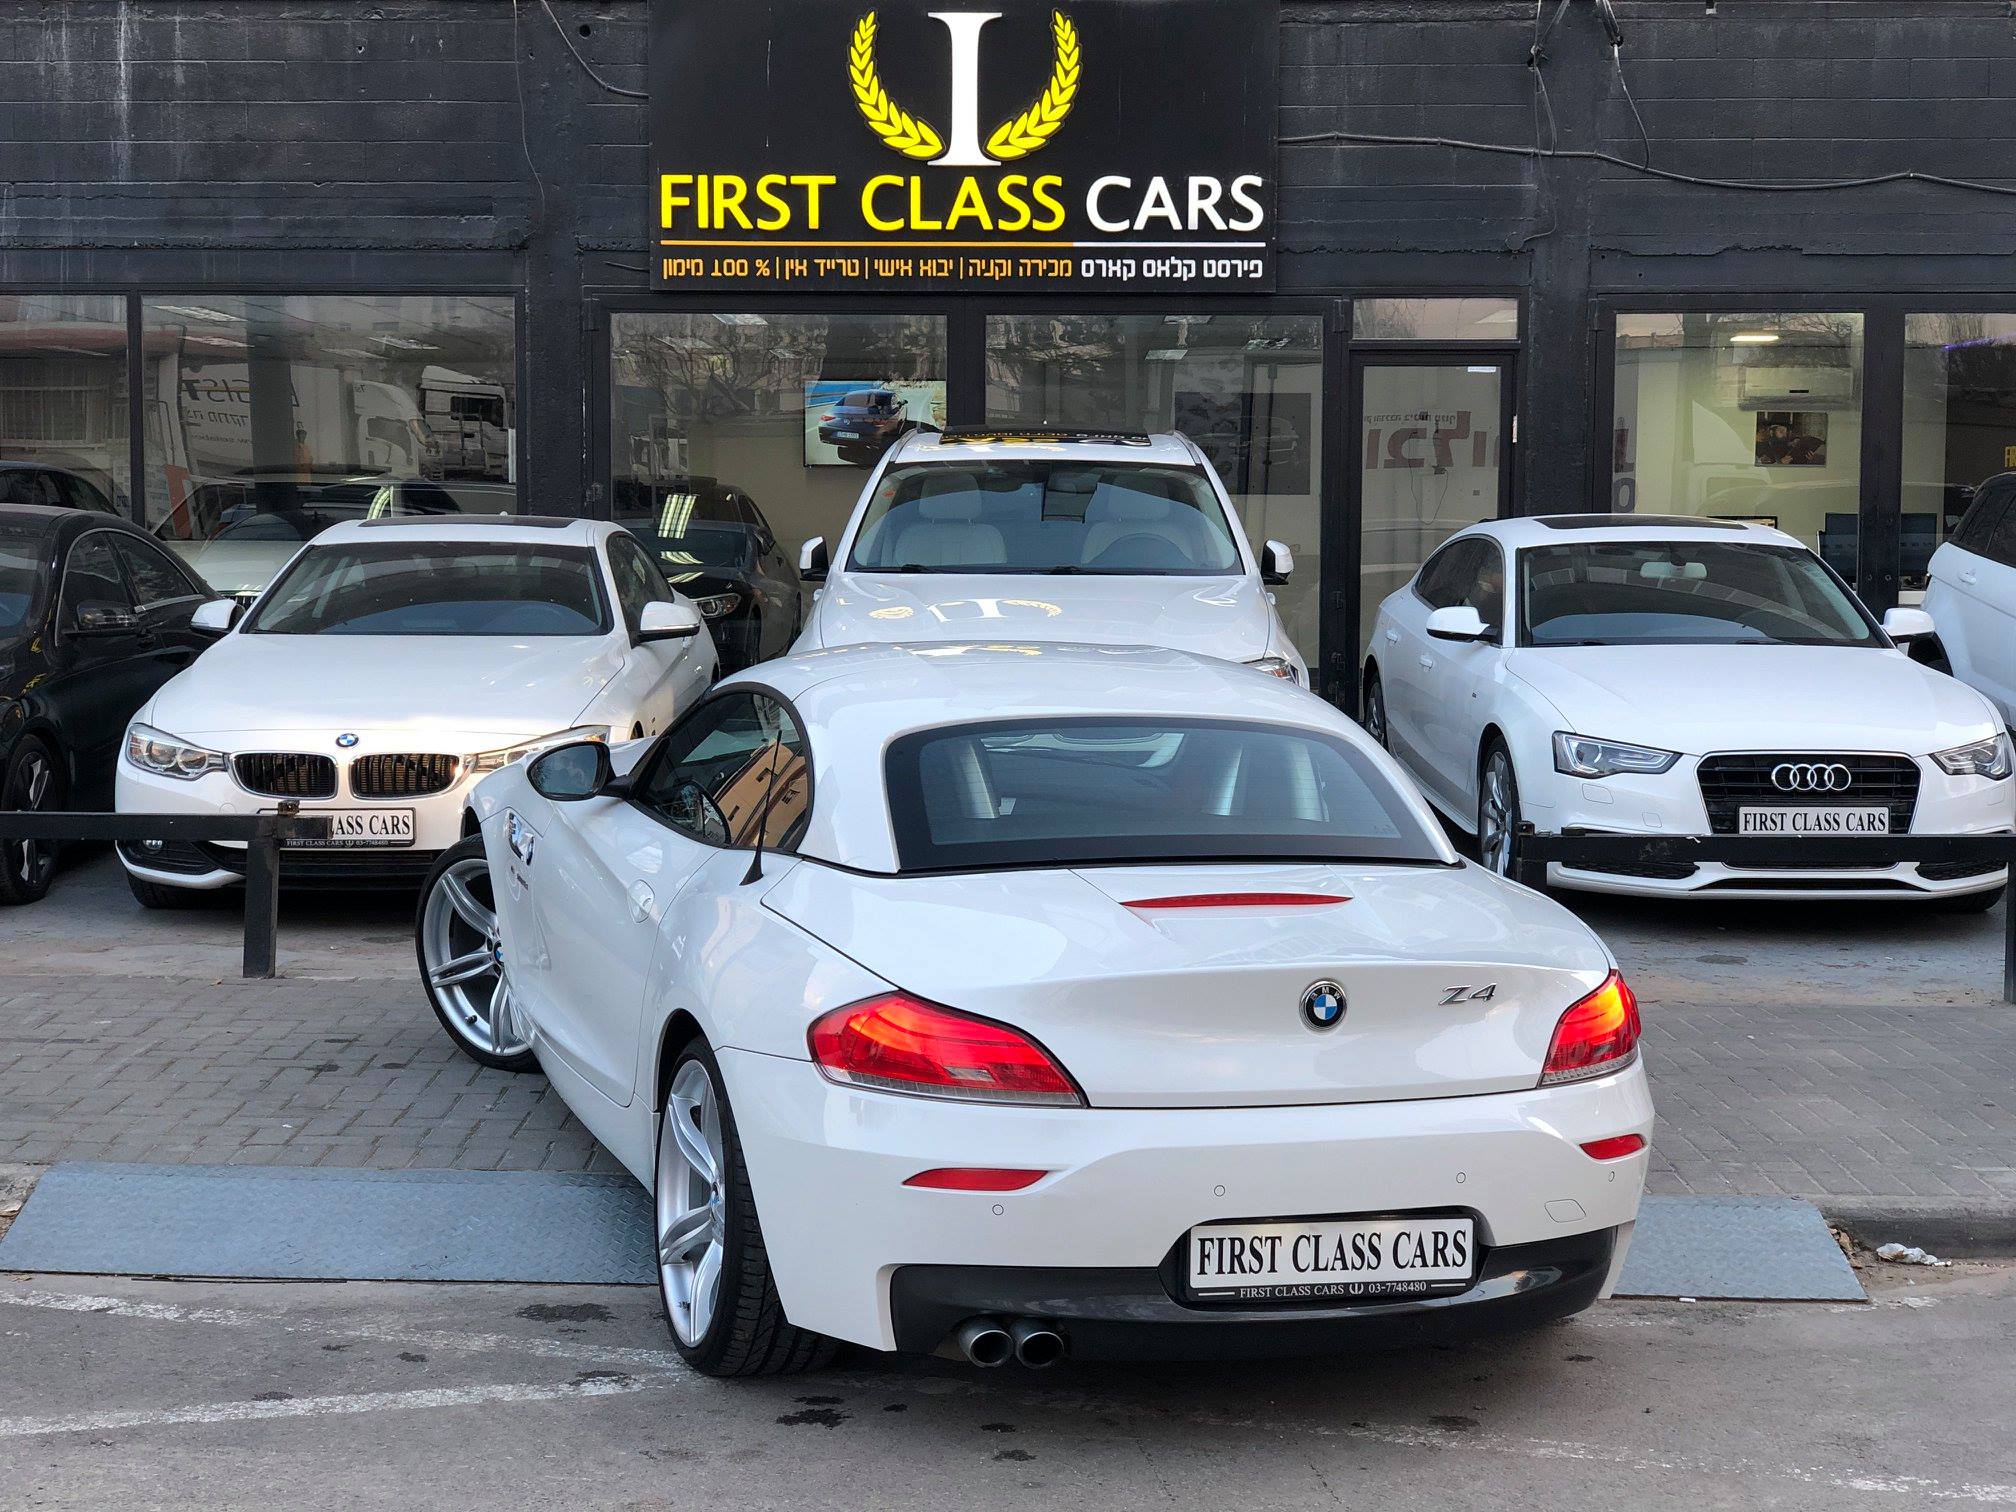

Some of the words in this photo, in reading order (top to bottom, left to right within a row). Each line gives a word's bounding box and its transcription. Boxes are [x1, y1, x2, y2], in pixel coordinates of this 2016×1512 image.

[660, 174, 836, 231] FIRST
[861, 174, 1066, 232] CLASS
[1085, 174, 1265, 232] CARS
[663, 259, 704, 280] מימון
[785, 259, 808, 280] אין
[814, 259, 860, 277] טרייד
[874, 259, 912, 277] אישי
[919, 259, 953, 277] יבוא
[968, 259, 1012, 281] וקניה
[1019, 259, 1072, 277] מכירה
[1081, 259, 1136, 281] קארס
[1142, 256, 1196, 281] קלאס
[1203, 259, 1263, 278] פירסט
[331, 815, 364, 836] ASS
[369, 815, 410, 836] CARS
[1743, 812, 1787, 832] FIRST
[1792, 812, 1841, 832] CLASS
[1846, 812, 1886, 832] CARS
[1438, 982, 1497, 1006] Z4
[1197, 1235, 1282, 1276] FIRST
[1292, 1232, 1382, 1273] CLASS
[1392, 1229, 1467, 1270] CARS
[1240, 1286, 1272, 1299] FIRST
[1275, 1285, 1311, 1298] CLASS
[1314, 1284, 1345, 1296] CARS
[1368, 1281, 1427, 1293] 03-7748480
